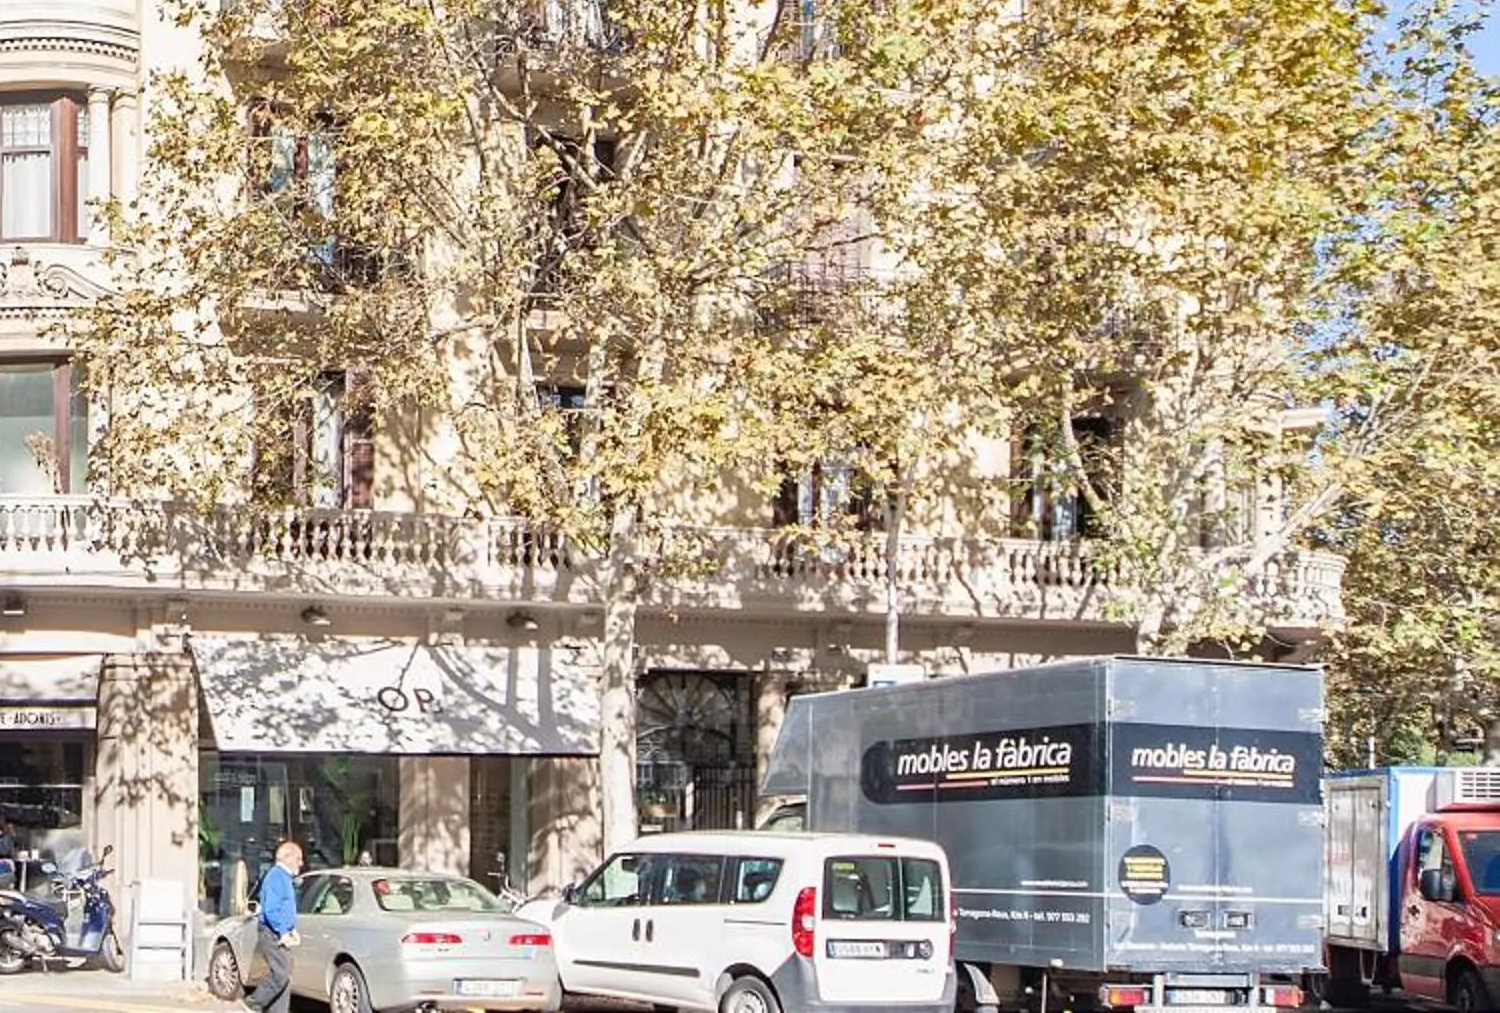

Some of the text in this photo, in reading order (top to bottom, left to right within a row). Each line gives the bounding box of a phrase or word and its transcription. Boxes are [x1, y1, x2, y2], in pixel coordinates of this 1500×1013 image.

[897, 736, 1071, 775] mobles la fàbrica
[1131, 743, 1296, 772] mobles la fàbrica
